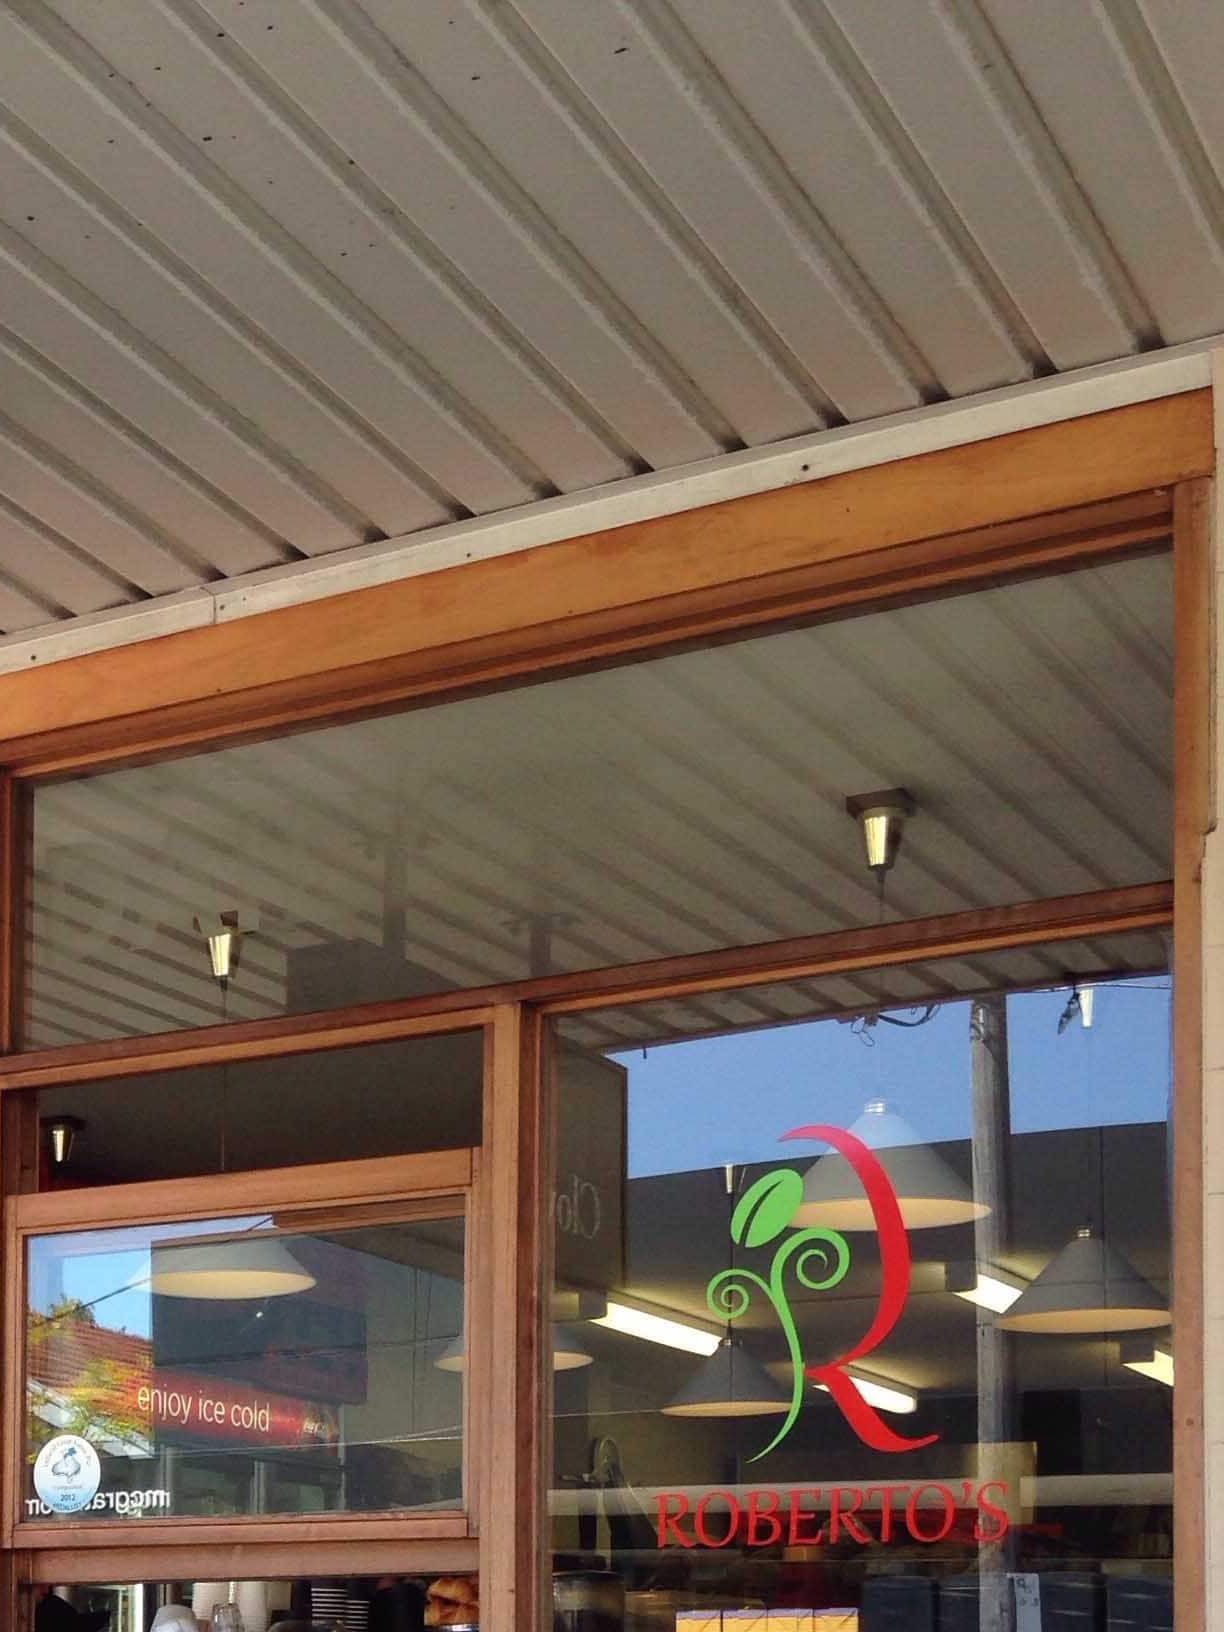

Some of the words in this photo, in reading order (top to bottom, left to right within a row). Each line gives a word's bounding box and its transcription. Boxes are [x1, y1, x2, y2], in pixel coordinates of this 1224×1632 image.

[137, 1384, 193, 1425] enjoy
[198, 1391, 226, 1424] ice
[230, 1389, 270, 1433] cold
[654, 1480, 1010, 1550] ROBERTO'S
